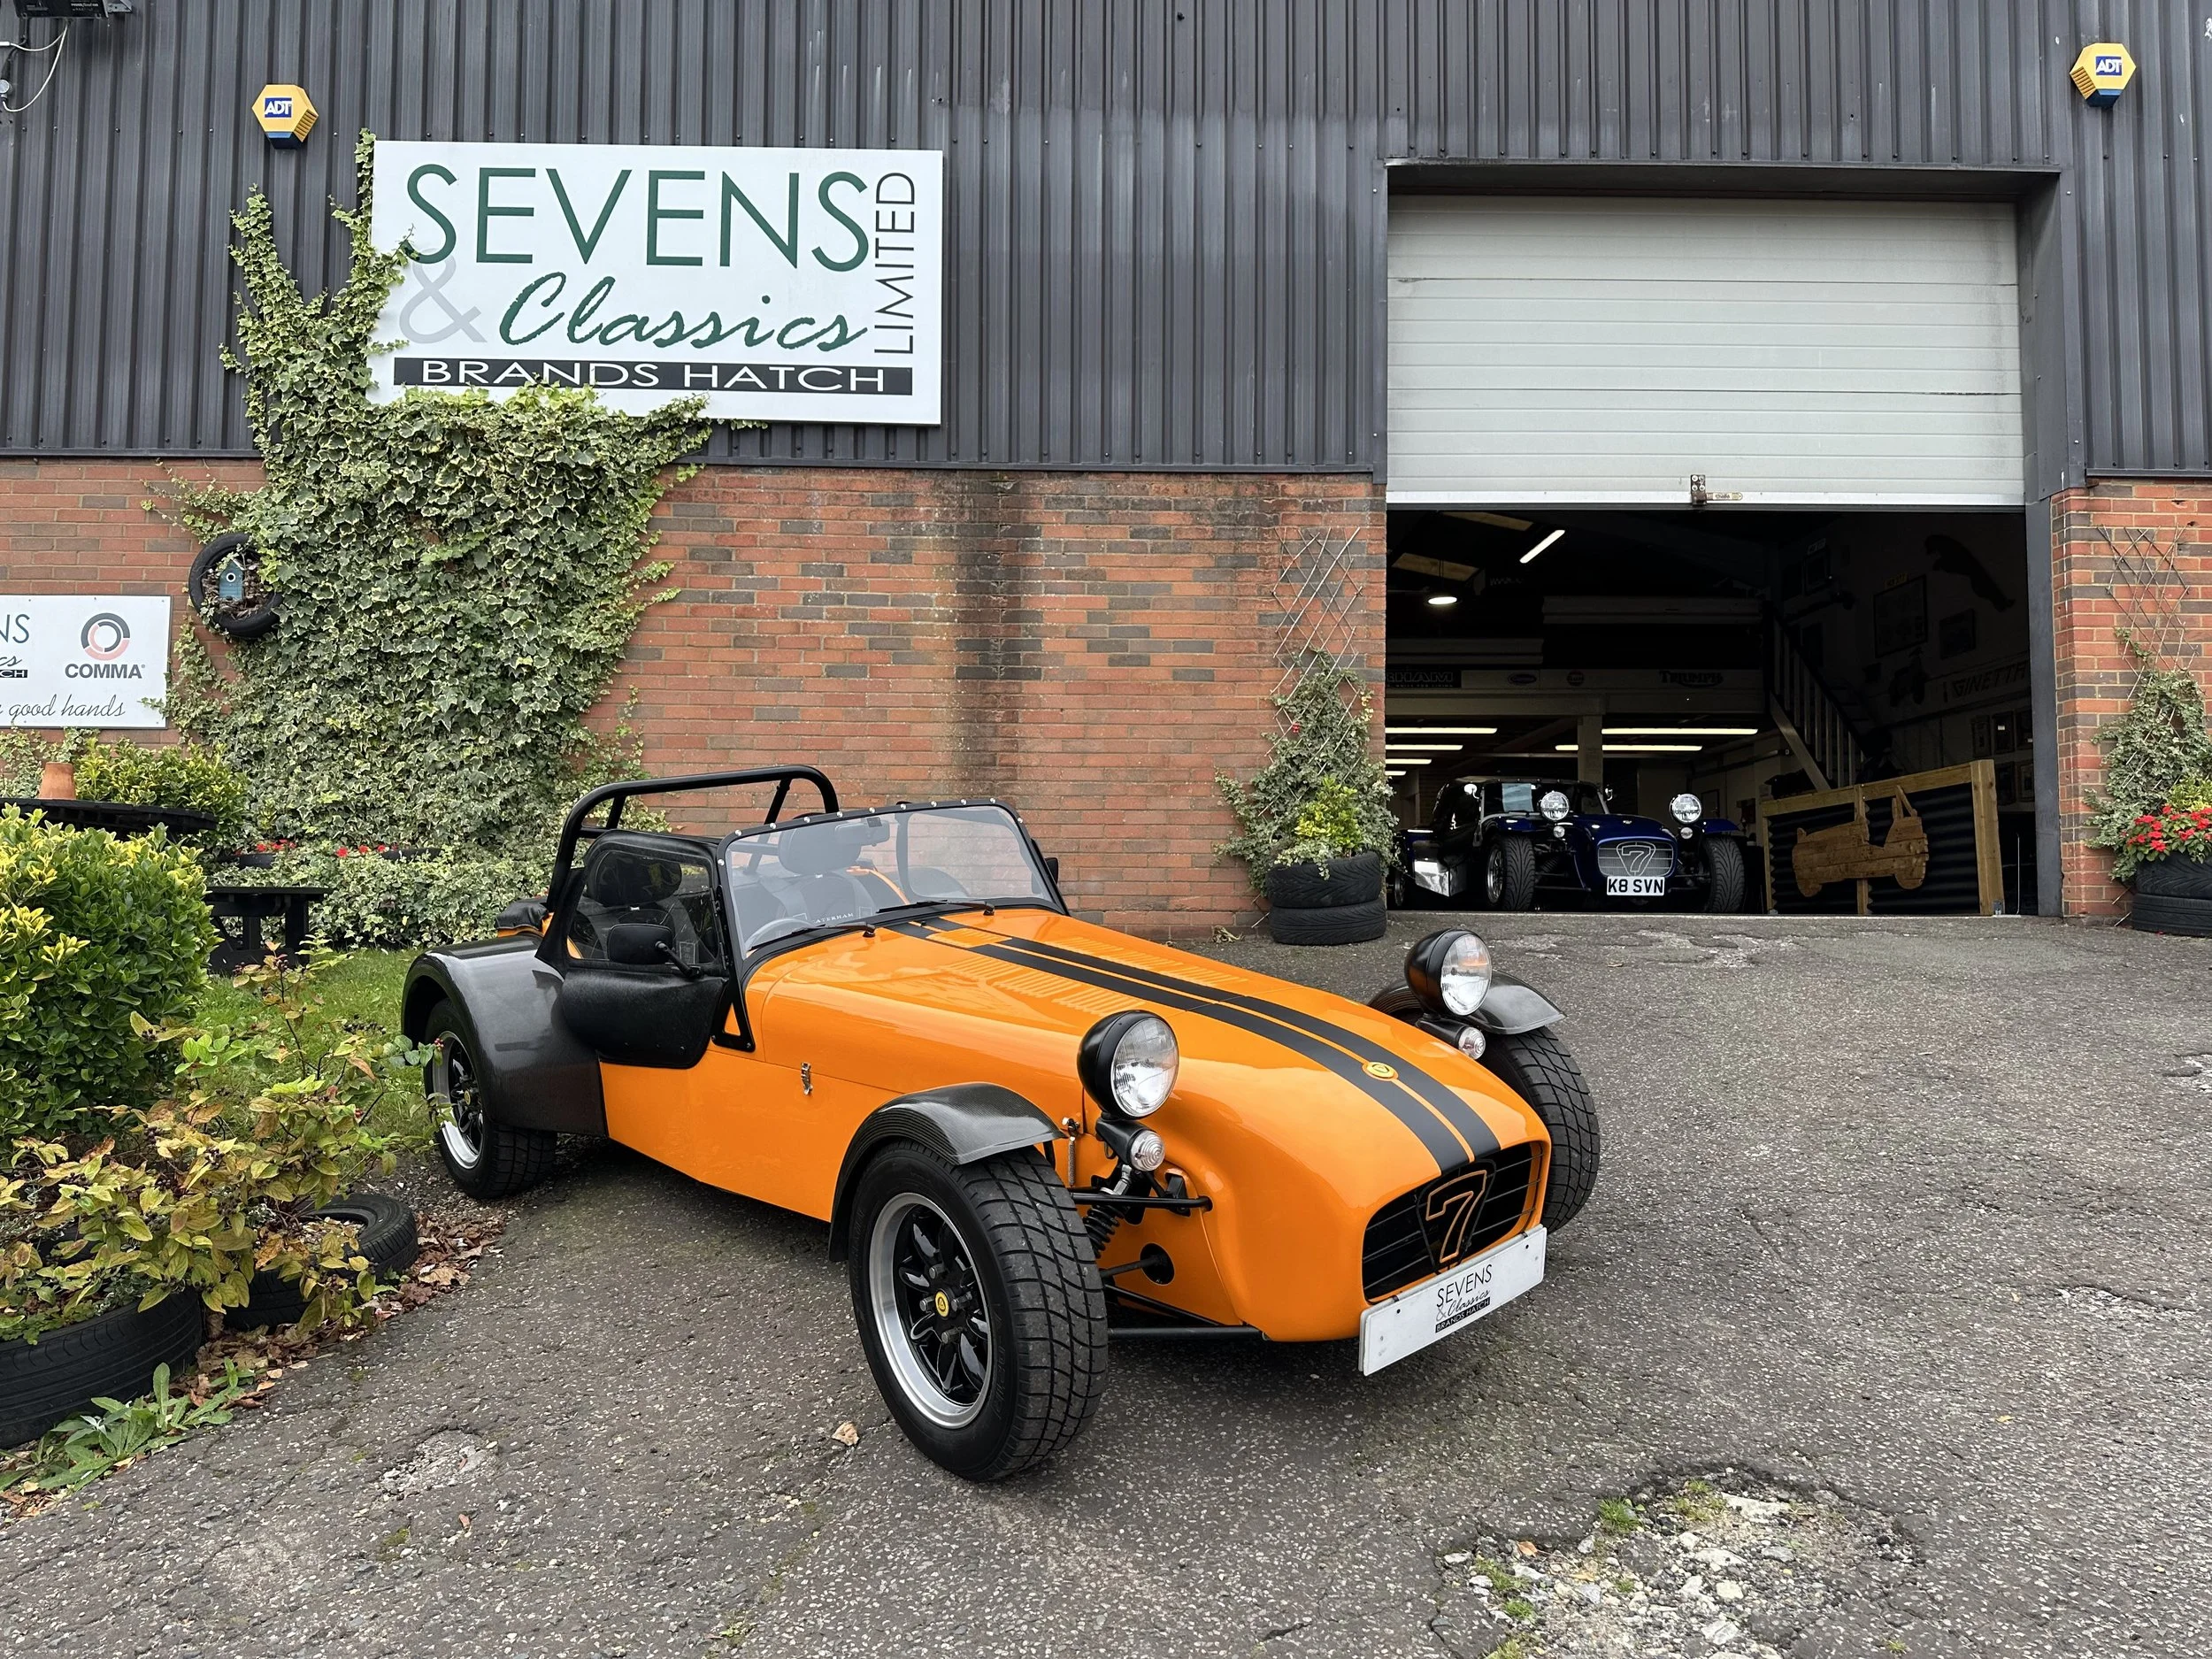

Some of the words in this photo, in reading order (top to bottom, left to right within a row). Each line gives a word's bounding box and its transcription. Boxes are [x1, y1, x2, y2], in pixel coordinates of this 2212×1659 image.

[2095, 58, 2123, 73] ADT
[264, 100, 293, 115] ADT
[402, 163, 870, 273] SEVENS
[874, 172, 916, 355] LIMITED
[398, 247, 488, 344] &
[498, 271, 869, 353] Classics
[421, 359, 660, 388] BRANDS
[683, 365, 886, 392] HATCH
[65, 663, 142, 680] COMMA
[9, 694, 57, 723] good
[61, 694, 126, 717] hands
[1621, 844, 1652, 872] 7
[1608, 879, 1628, 894] K8
[1632, 879, 1663, 894] SVN
[1425, 1169, 1487, 1263] 7
[1436, 1263, 1493, 1308] SEVENS
[1436, 1311, 1465, 1332] BRANDS
[1465, 1299, 1490, 1317] HATCH
[1448, 1289, 1491, 1317] Classics
